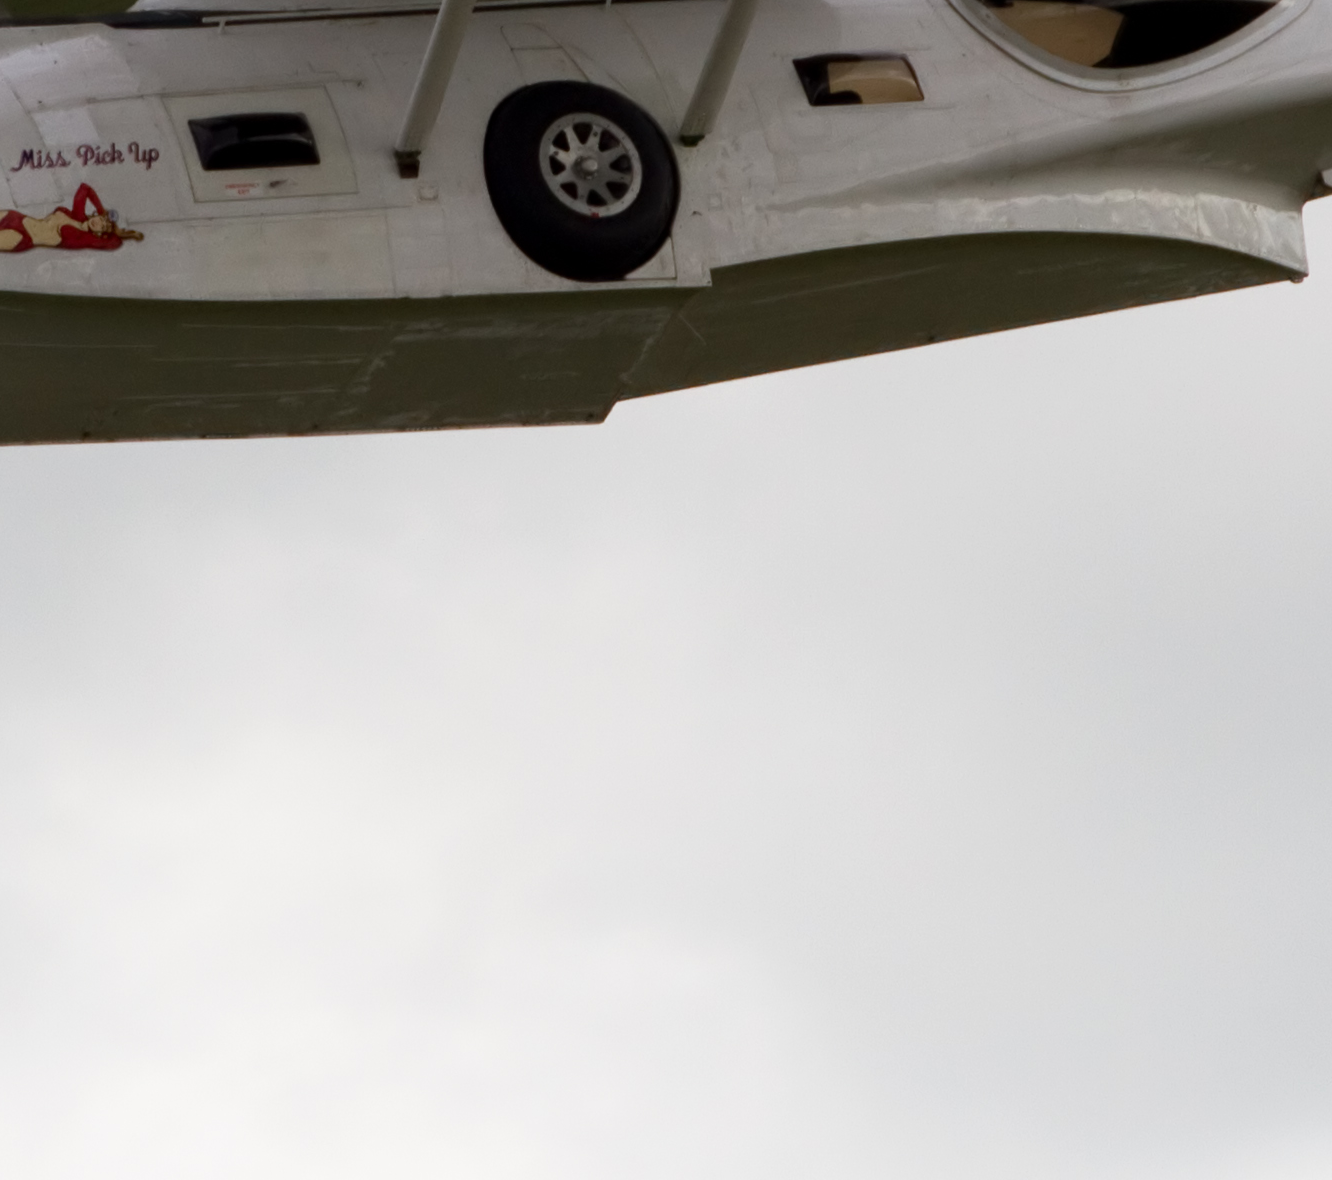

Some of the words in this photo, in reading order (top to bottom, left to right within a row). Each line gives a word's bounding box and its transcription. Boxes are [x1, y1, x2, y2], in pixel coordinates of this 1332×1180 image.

[11, 148, 71, 172] Miss
[76, 142, 125, 167] Pick
[127, 141, 160, 170] Up
